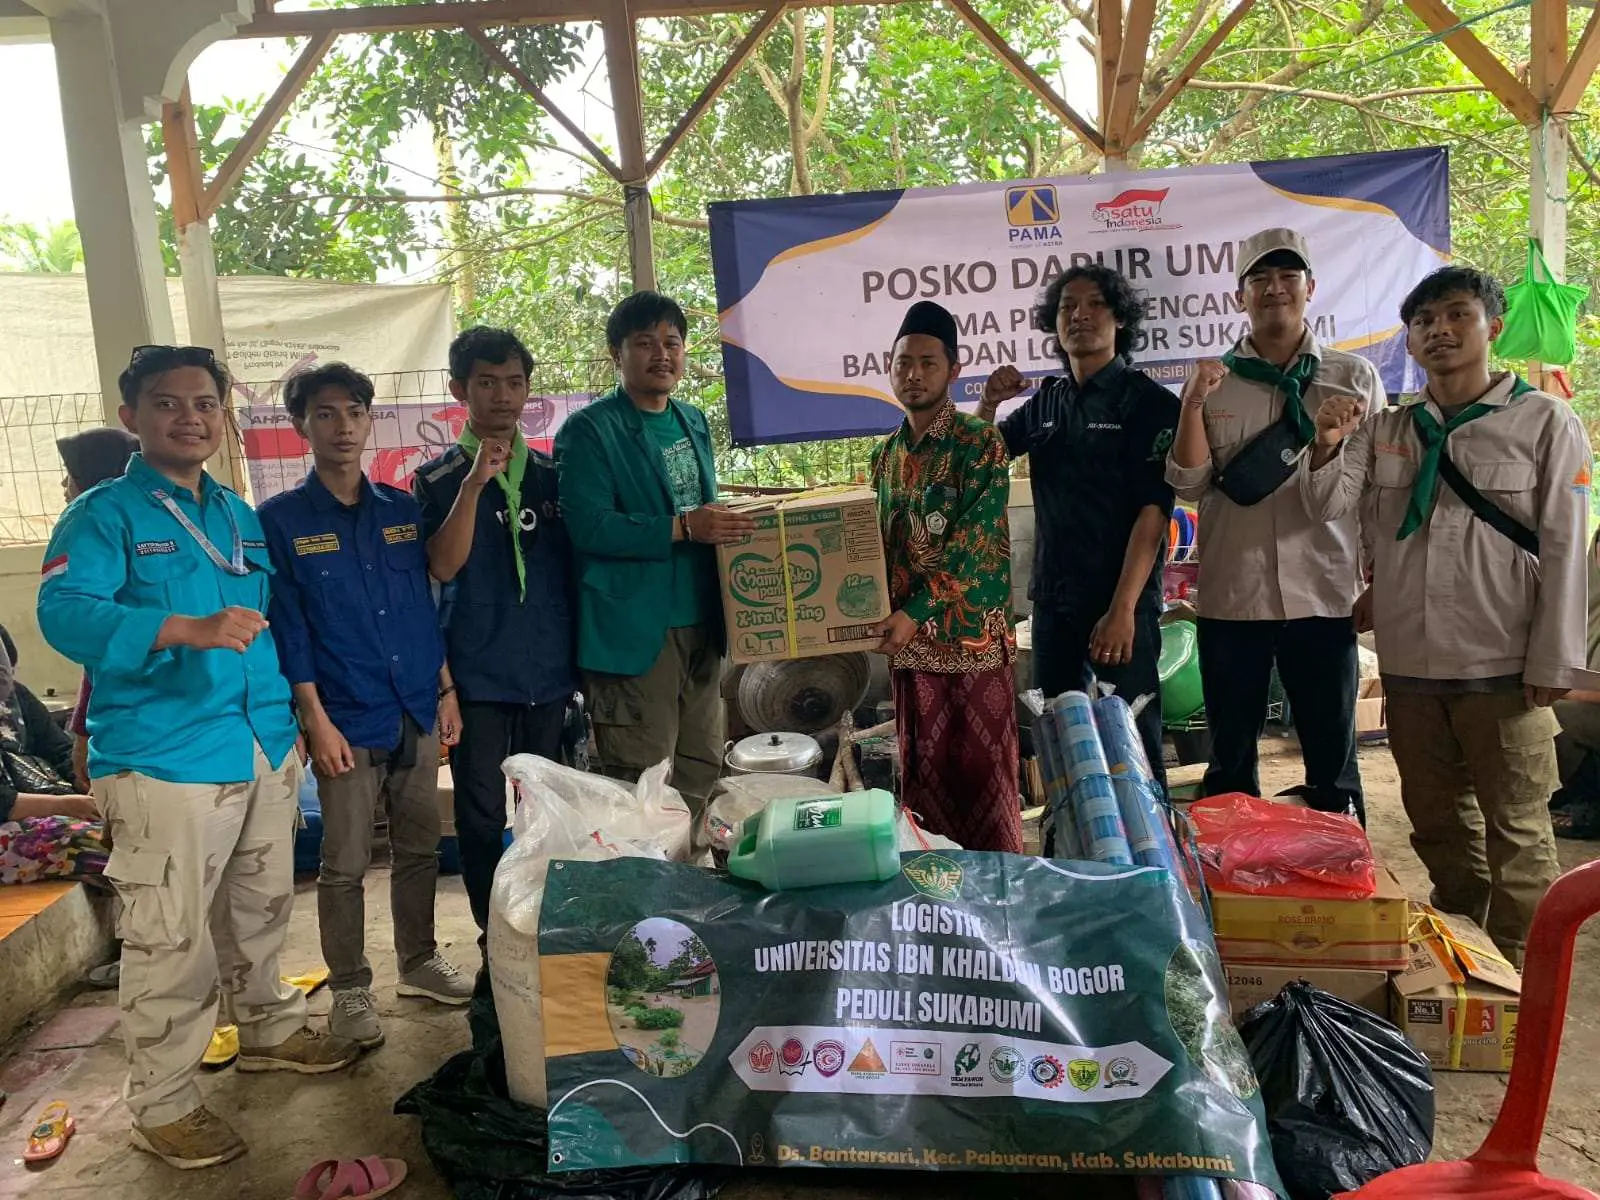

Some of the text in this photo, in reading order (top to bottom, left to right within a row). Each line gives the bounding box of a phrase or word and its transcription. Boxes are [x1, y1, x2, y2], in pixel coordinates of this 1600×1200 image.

[1104, 215, 1162, 229] Indonesia
[1111, 205, 1153, 219] satu
[1008, 225, 1062, 242] PAMA
[862, 260, 997, 303] POSKO
[754, 940, 891, 973] UNIVERSITAS
[897, 943, 933, 975] IBN
[1048, 964, 1125, 995] BOGOR
[836, 987, 1042, 1033] PEDULI SUKABUMI
[777, 1145, 1236, 1172] Ds. Bantarsari, Kec. Pabuaran, Kab. Sukabumi
